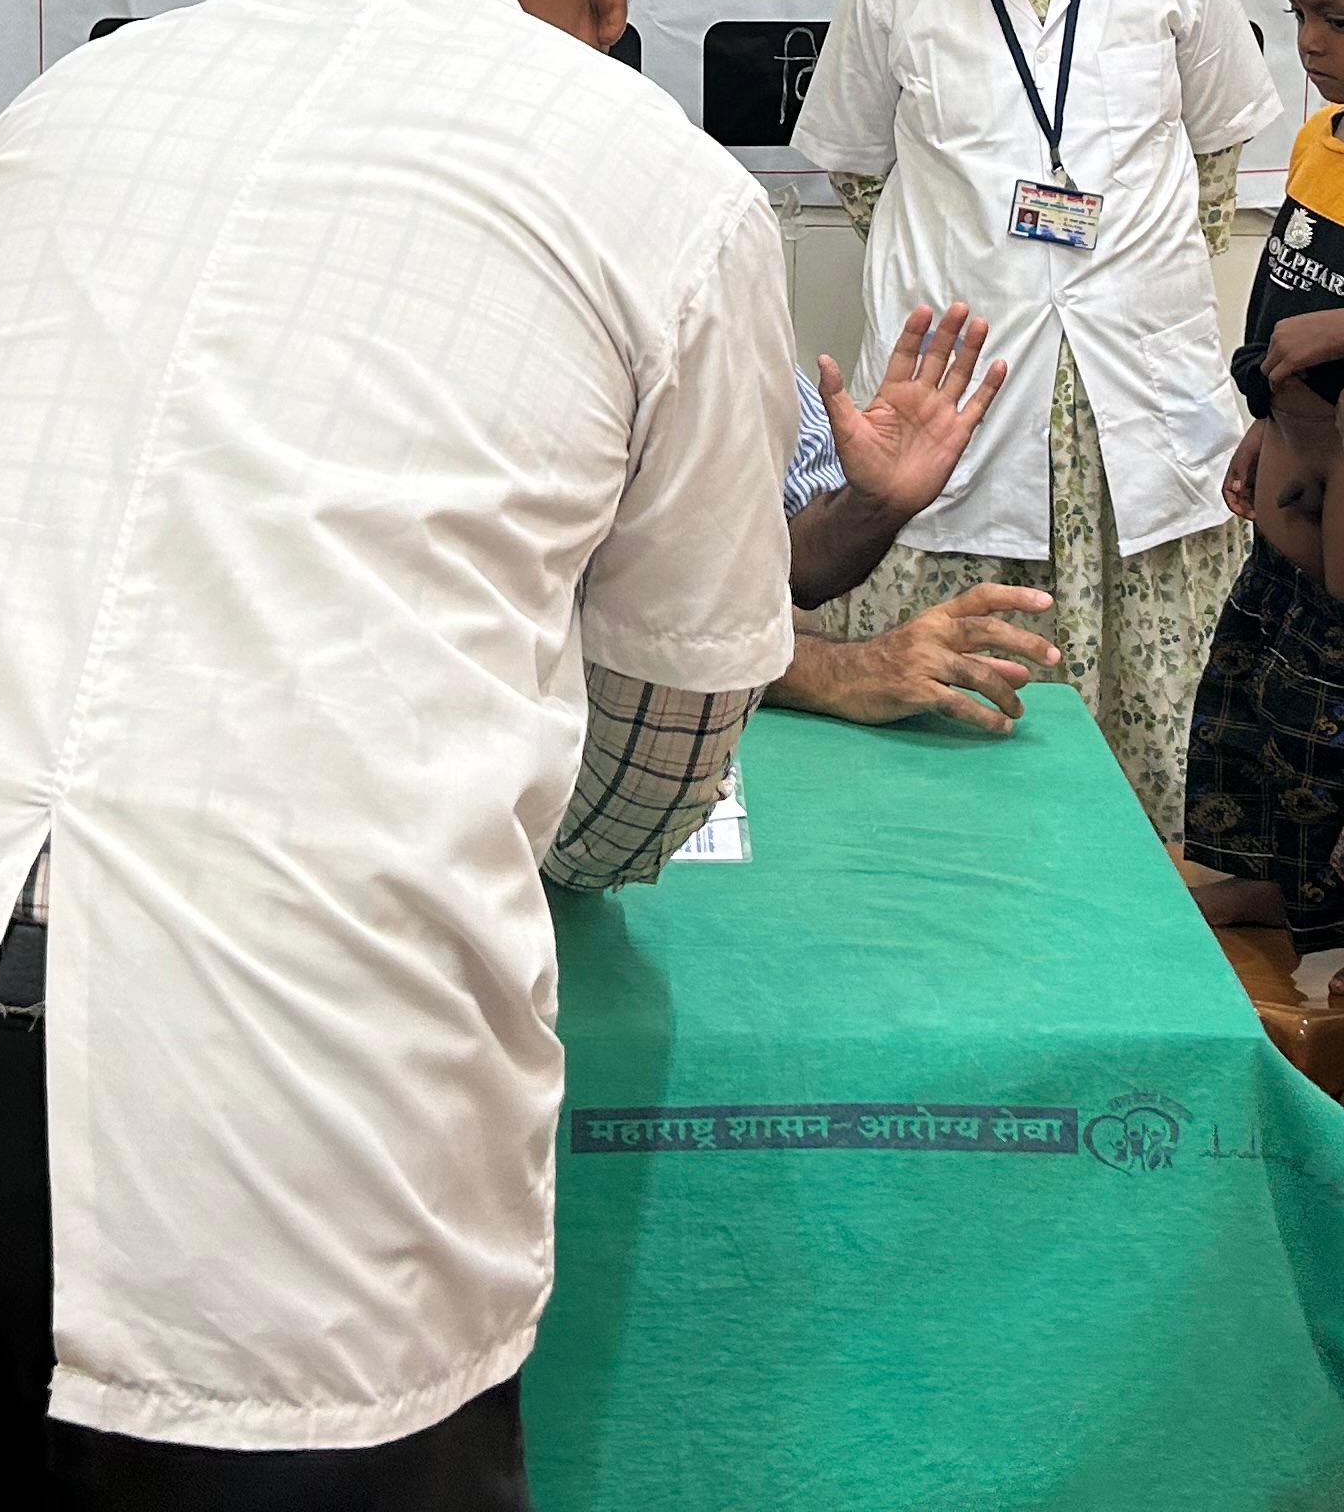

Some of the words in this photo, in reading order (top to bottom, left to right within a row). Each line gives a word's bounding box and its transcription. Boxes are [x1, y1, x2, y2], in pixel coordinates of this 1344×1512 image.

[725, 1115, 831, 1142] शासन
[859, 1106, 981, 1141] आरोग्य
[991, 1108, 1063, 1143] सेवा
